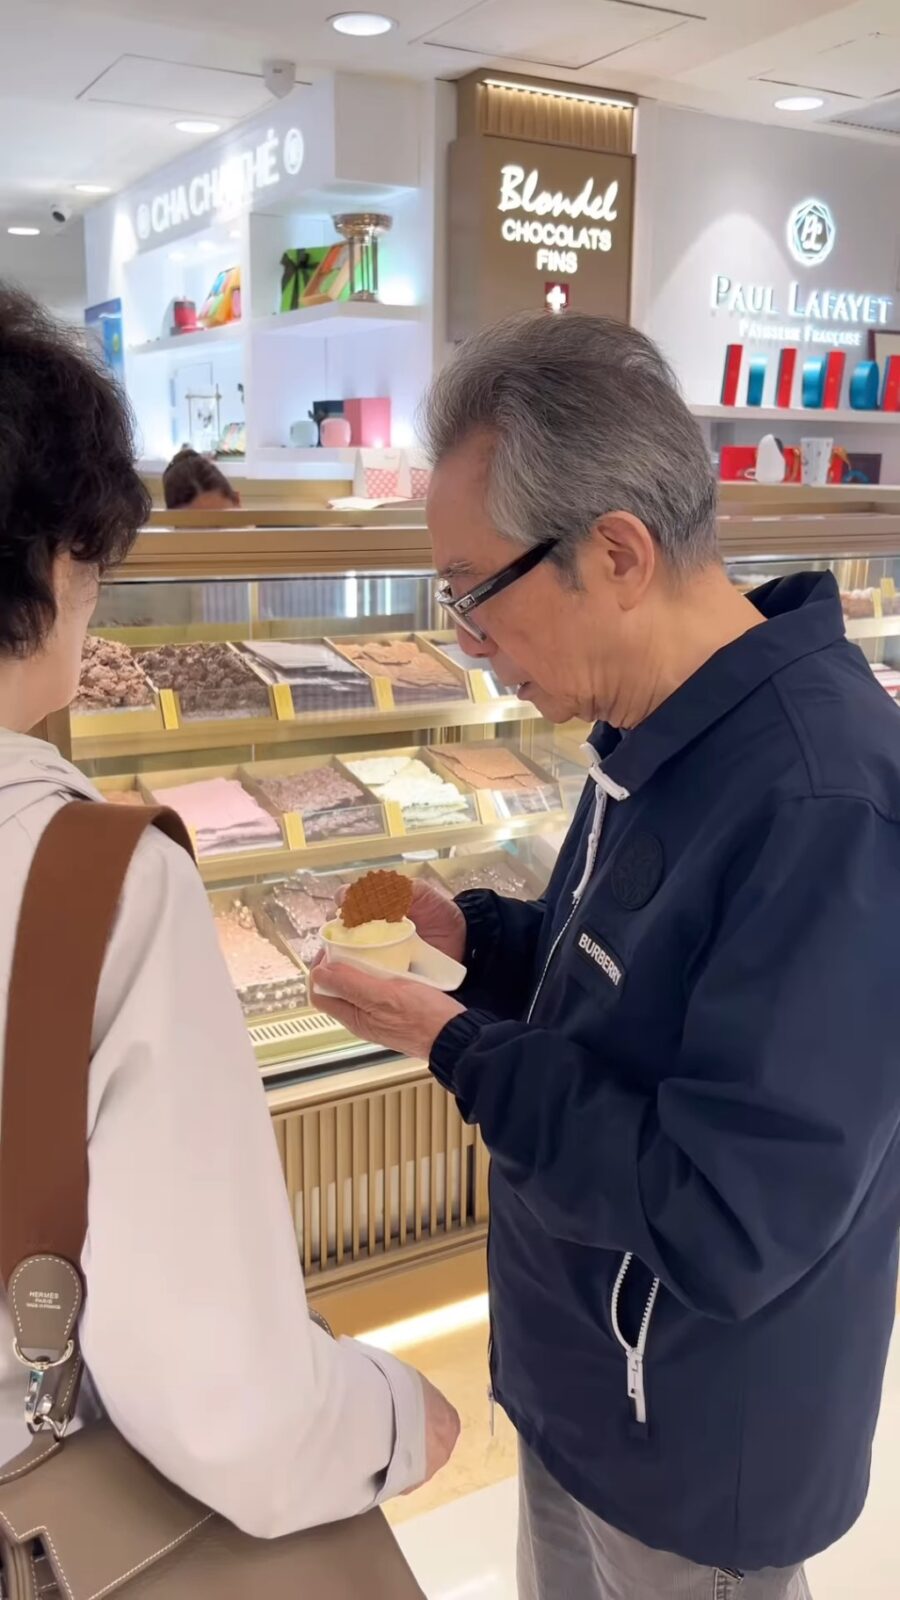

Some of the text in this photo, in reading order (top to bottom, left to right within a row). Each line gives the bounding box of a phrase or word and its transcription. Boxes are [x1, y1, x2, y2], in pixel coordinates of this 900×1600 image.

[151, 185, 190, 233] CHA
[498, 164, 619, 222] Blondel
[502, 218, 612, 252] CHOCOLATS
[536, 249, 578, 274] FINS
[710, 273, 893, 325] PAUL LAFAYET
[578, 932, 622, 987] BURBERRY
